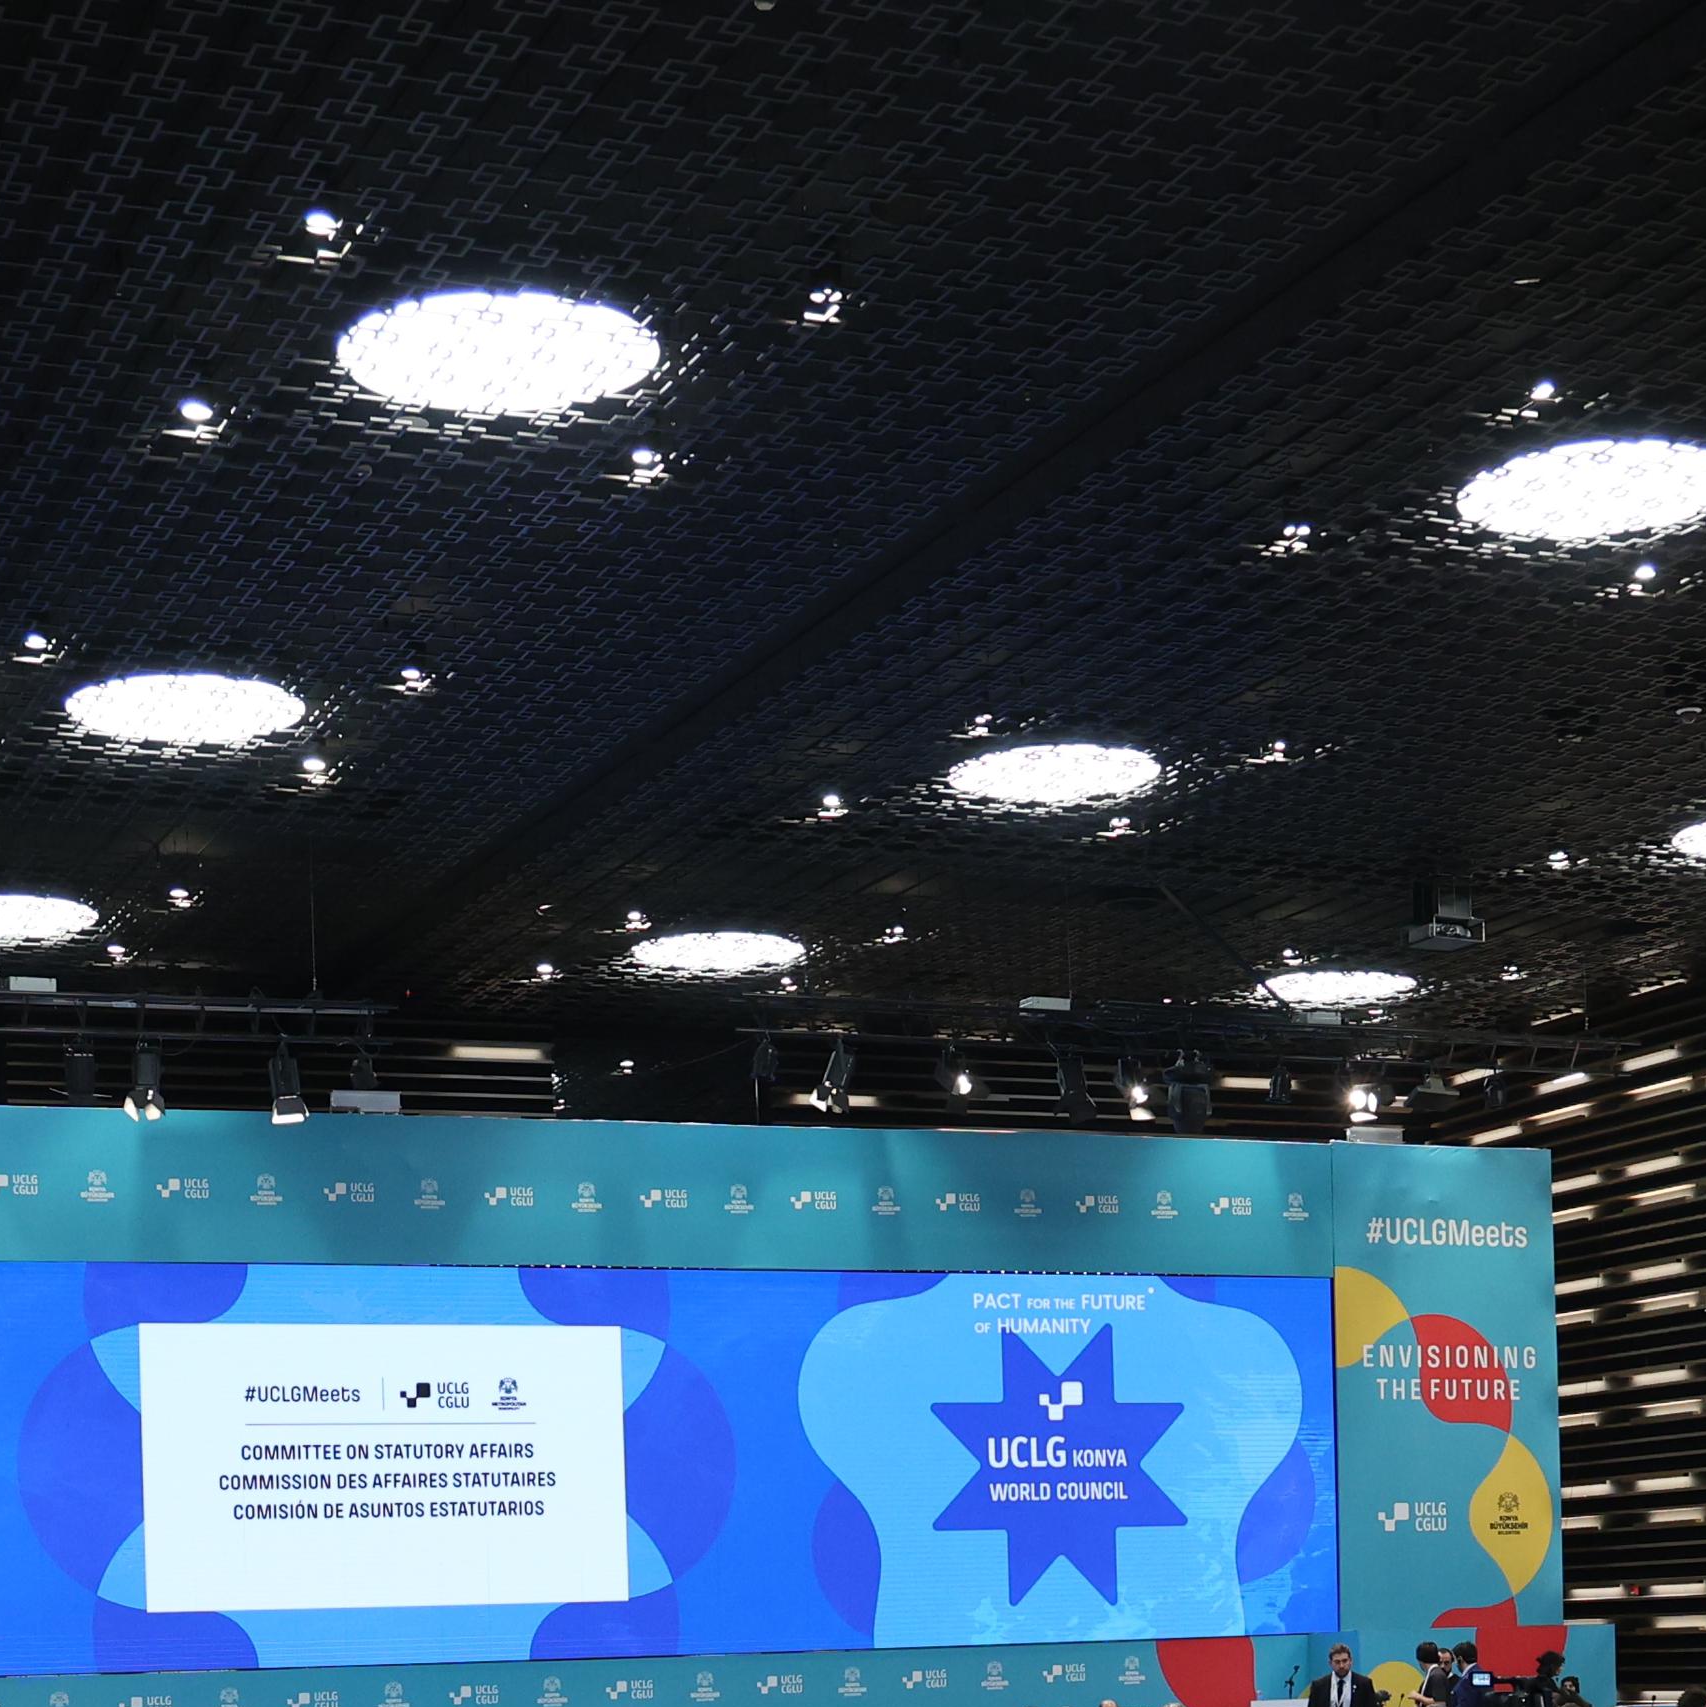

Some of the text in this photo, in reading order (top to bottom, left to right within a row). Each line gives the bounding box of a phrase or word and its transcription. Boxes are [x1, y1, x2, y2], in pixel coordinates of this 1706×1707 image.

[12, 1174, 39, 1184] UCLG
[184, 1178, 210, 1188] UCLG
[12, 1185, 39, 1196] CGLU
[350, 1182, 375, 1192] UCLG
[509, 1186, 534, 1196] UCLG
[184, 1189, 210, 1199] CGLU
[350, 1193, 375, 1203] CGLU
[664, 1189, 688, 1198] UCLG
[814, 1191, 837, 1200] UCLG
[958, 1193, 981, 1202] UCLG
[509, 1197, 534, 1207] CGLU
[664, 1199, 688, 1209] CGLU
[1097, 1195, 1119, 1204] UCLG
[1231, 1196, 1252, 1206] UCLG
[814, 1201, 837, 1210] CGLU
[958, 1203, 981, 1212] CGLU
[1097, 1205, 1119, 1214] CGLU
[1231, 1207, 1252, 1216] CGLU
[1367, 1218, 1527, 1247] #UCLGMeets
[974, 1293, 1145, 1310] PACT FOR THE FUTURE
[975, 1318, 1090, 1333] OF HUMANITY
[1363, 1344, 1536, 1369] ENVISIONING
[438, 1382, 468, 1394] UCLG
[1377, 1378, 1521, 1401] THE FUTURE
[245, 1386, 360, 1402] #UCLGMeets
[438, 1396, 469, 1408] CGLU
[242, 1444, 533, 1460] COMMITTEE ON STATUTORY AFFAIRS
[988, 1436, 1127, 1468] UCLG KONYA
[220, 1472, 555, 1490] COMMISSION DES AFFAIRES STATUTAIRES
[990, 1482, 1128, 1501] WORLD COUNCIL
[234, 1501, 544, 1519] COMISIÓN DE ASUNTOS ESTATUTARIOS
[1415, 1502, 1446, 1516] UCLG
[1416, 1518, 1446, 1531] CGLU
[1064, 1663, 1086, 1672] UCLG
[925, 1668, 947, 1678] UCLG
[1064, 1673, 1086, 1682] CGLU
[630, 1679, 654, 1689] UCLG
[780, 1674, 803, 1684] UCLG
[925, 1679, 947, 1689] CGLU
[475, 1684, 499, 1694] UCLG
[780, 1685, 803, 1694] CGLU
[146, 1695, 172, 1705] UCLG
[313, 1691, 339, 1701] UCLG
[475, 1695, 499, 1705] CGLU
[630, 1690, 654, 1700] CGLU
